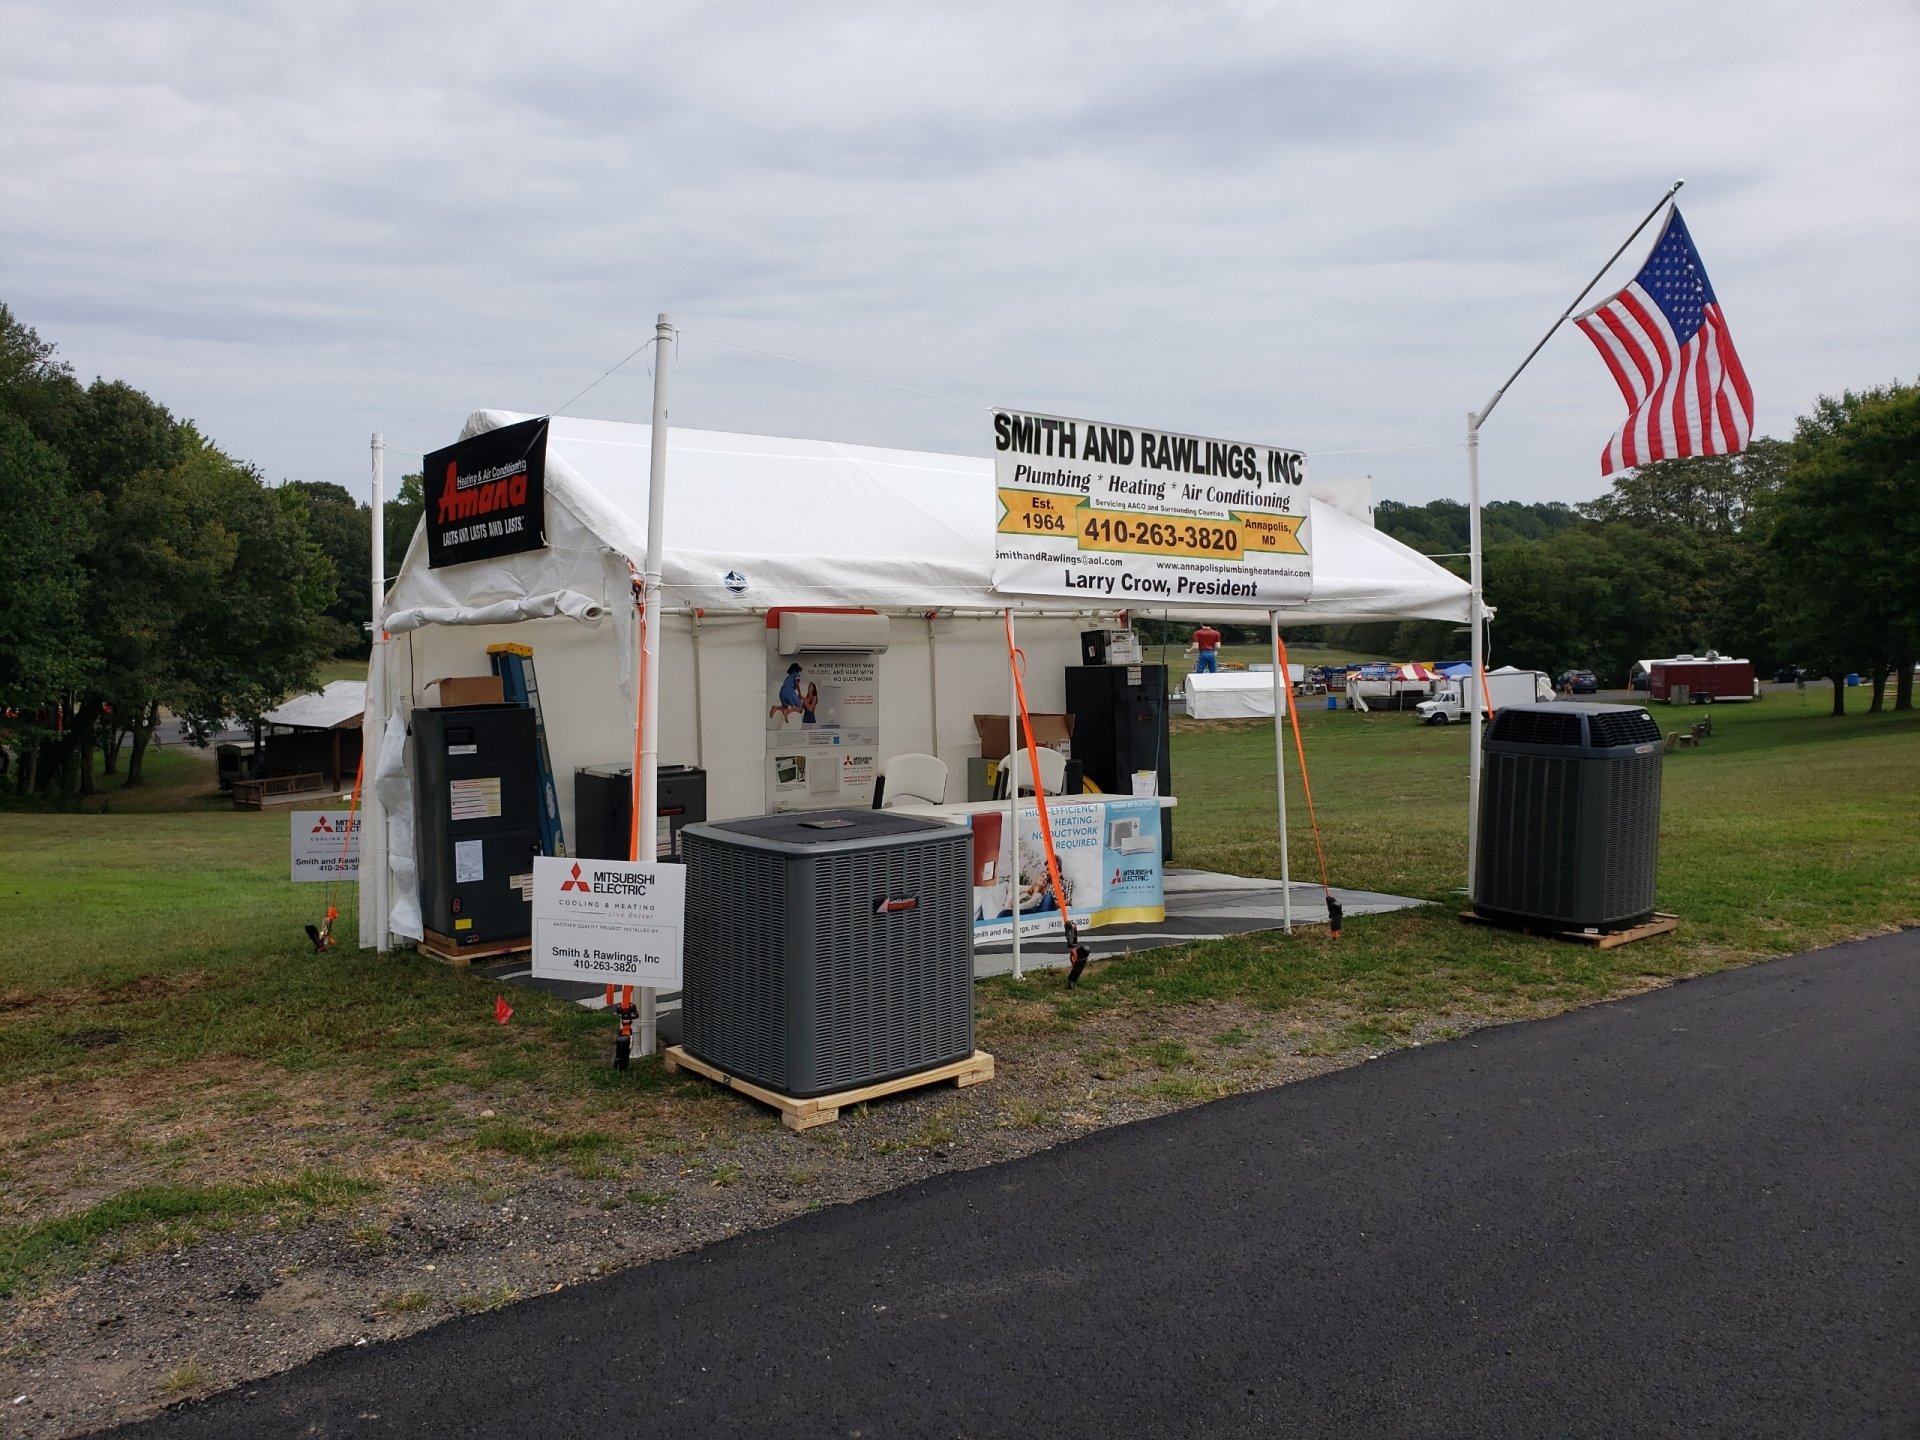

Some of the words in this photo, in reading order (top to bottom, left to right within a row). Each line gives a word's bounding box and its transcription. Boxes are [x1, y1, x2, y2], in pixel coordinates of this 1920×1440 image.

[995, 413, 1076, 460] SMITH
[1083, 425, 1134, 465] AND
[1141, 433, 1262, 489] RAWLINGS,
[1268, 450, 1304, 486] INC
[457, 474, 477, 487] Heating
[478, 470, 482, 481] &
[483, 469, 492, 481] Air
[438, 461, 528, 524] Amana
[1014, 464, 1091, 492] Plumbing
[1109, 474, 1166, 500] Heating
[1182, 484, 1203, 501] Air
[1207, 487, 1291, 512] Conditioning
[1032, 497, 1054, 511] Est.
[1096, 499, 1126, 510] Servicing
[1127, 502, 1146, 510] AACO
[1161, 506, 1197, 516] Surrounding
[1198, 509, 1225, 518] Counties
[1022, 513, 1065, 531] 1964
[1245, 517, 1291, 534] Annapolis,
[443, 530, 459, 547] LASTS
[459, 527, 470, 543] AND
[470, 523, 487, 541] LASTS
[488, 520, 503, 537] AND
[1084, 517, 1238, 551] 410-263-3820
[1262, 534, 1276, 546] MD
[995, 549, 1123, 568] SmithandRawlings@aol.com
[1157, 561, 1310, 579] www.annapolisplumbingheatandair.com
[1066, 569, 1113, 594] Larry
[1121, 572, 1171, 597] Crow,
[1177, 576, 1258, 598] President
[1056, 838, 1099, 849] REQUIRED.
[296, 858, 319, 866] Smith
[594, 871, 655, 886] MITSUBISHI
[594, 883, 646, 896] ELECTRIC
[559, 900, 600, 908] COOLING
[615, 903, 655, 911] HEATING
[990, 927, 1001, 936] and
[1031, 923, 1040, 931] Inc
[552, 946, 580, 958] Smith
[584, 950, 590, 959] &
[594, 950, 641, 964] Rawlings,
[644, 954, 660, 964] Inc
[574, 959, 637, 973] 410-263-3820
